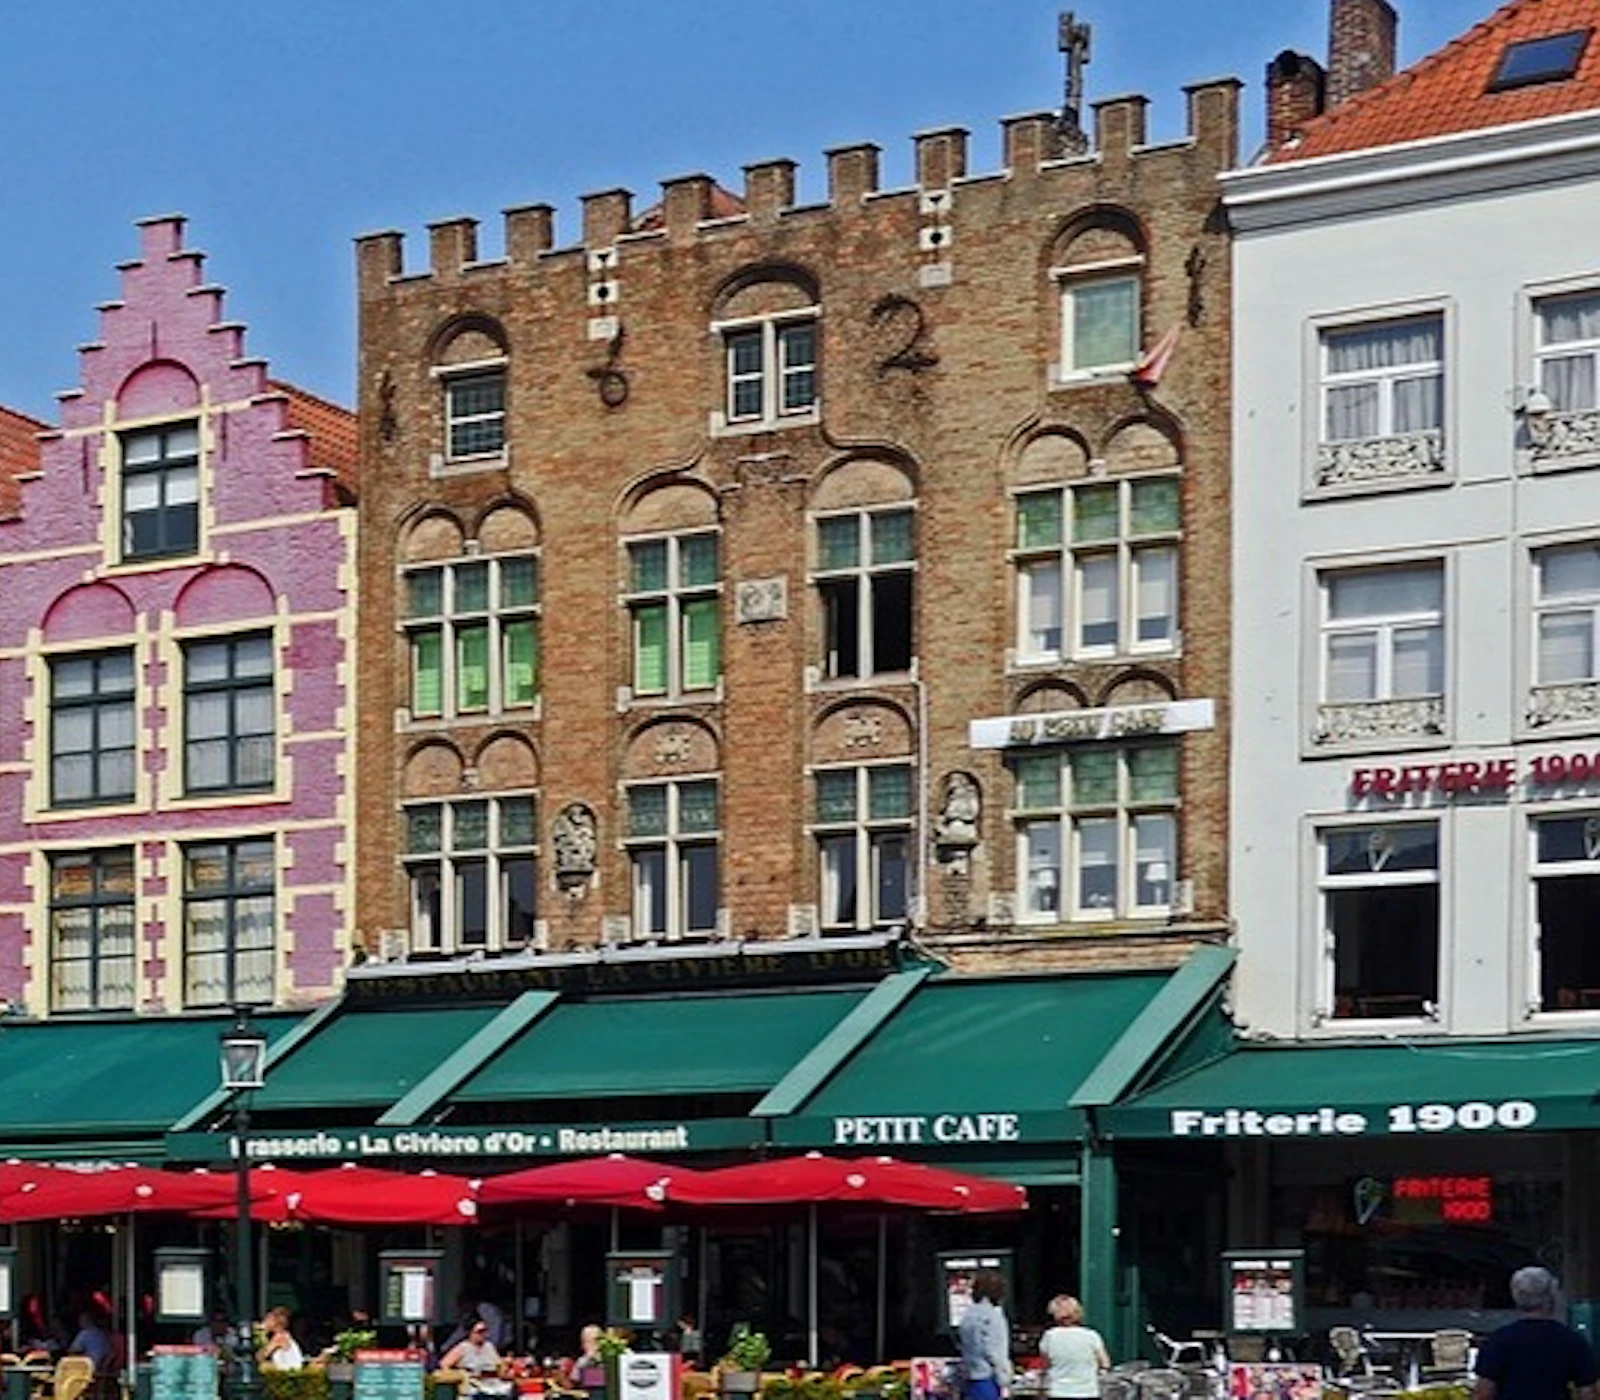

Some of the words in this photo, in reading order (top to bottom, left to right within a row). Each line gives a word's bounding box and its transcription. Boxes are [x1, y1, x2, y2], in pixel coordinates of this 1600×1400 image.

[1352, 759, 1517, 796] FRITERIE
[833, 1116, 928, 1145] PETIT
[1170, 1107, 1368, 1136] Friterie
[1388, 1100, 1538, 1133] 1900
[360, 1133, 391, 1154] La
[484, 1130, 537, 1153] d'Or
[558, 1125, 689, 1151] Restaurant
